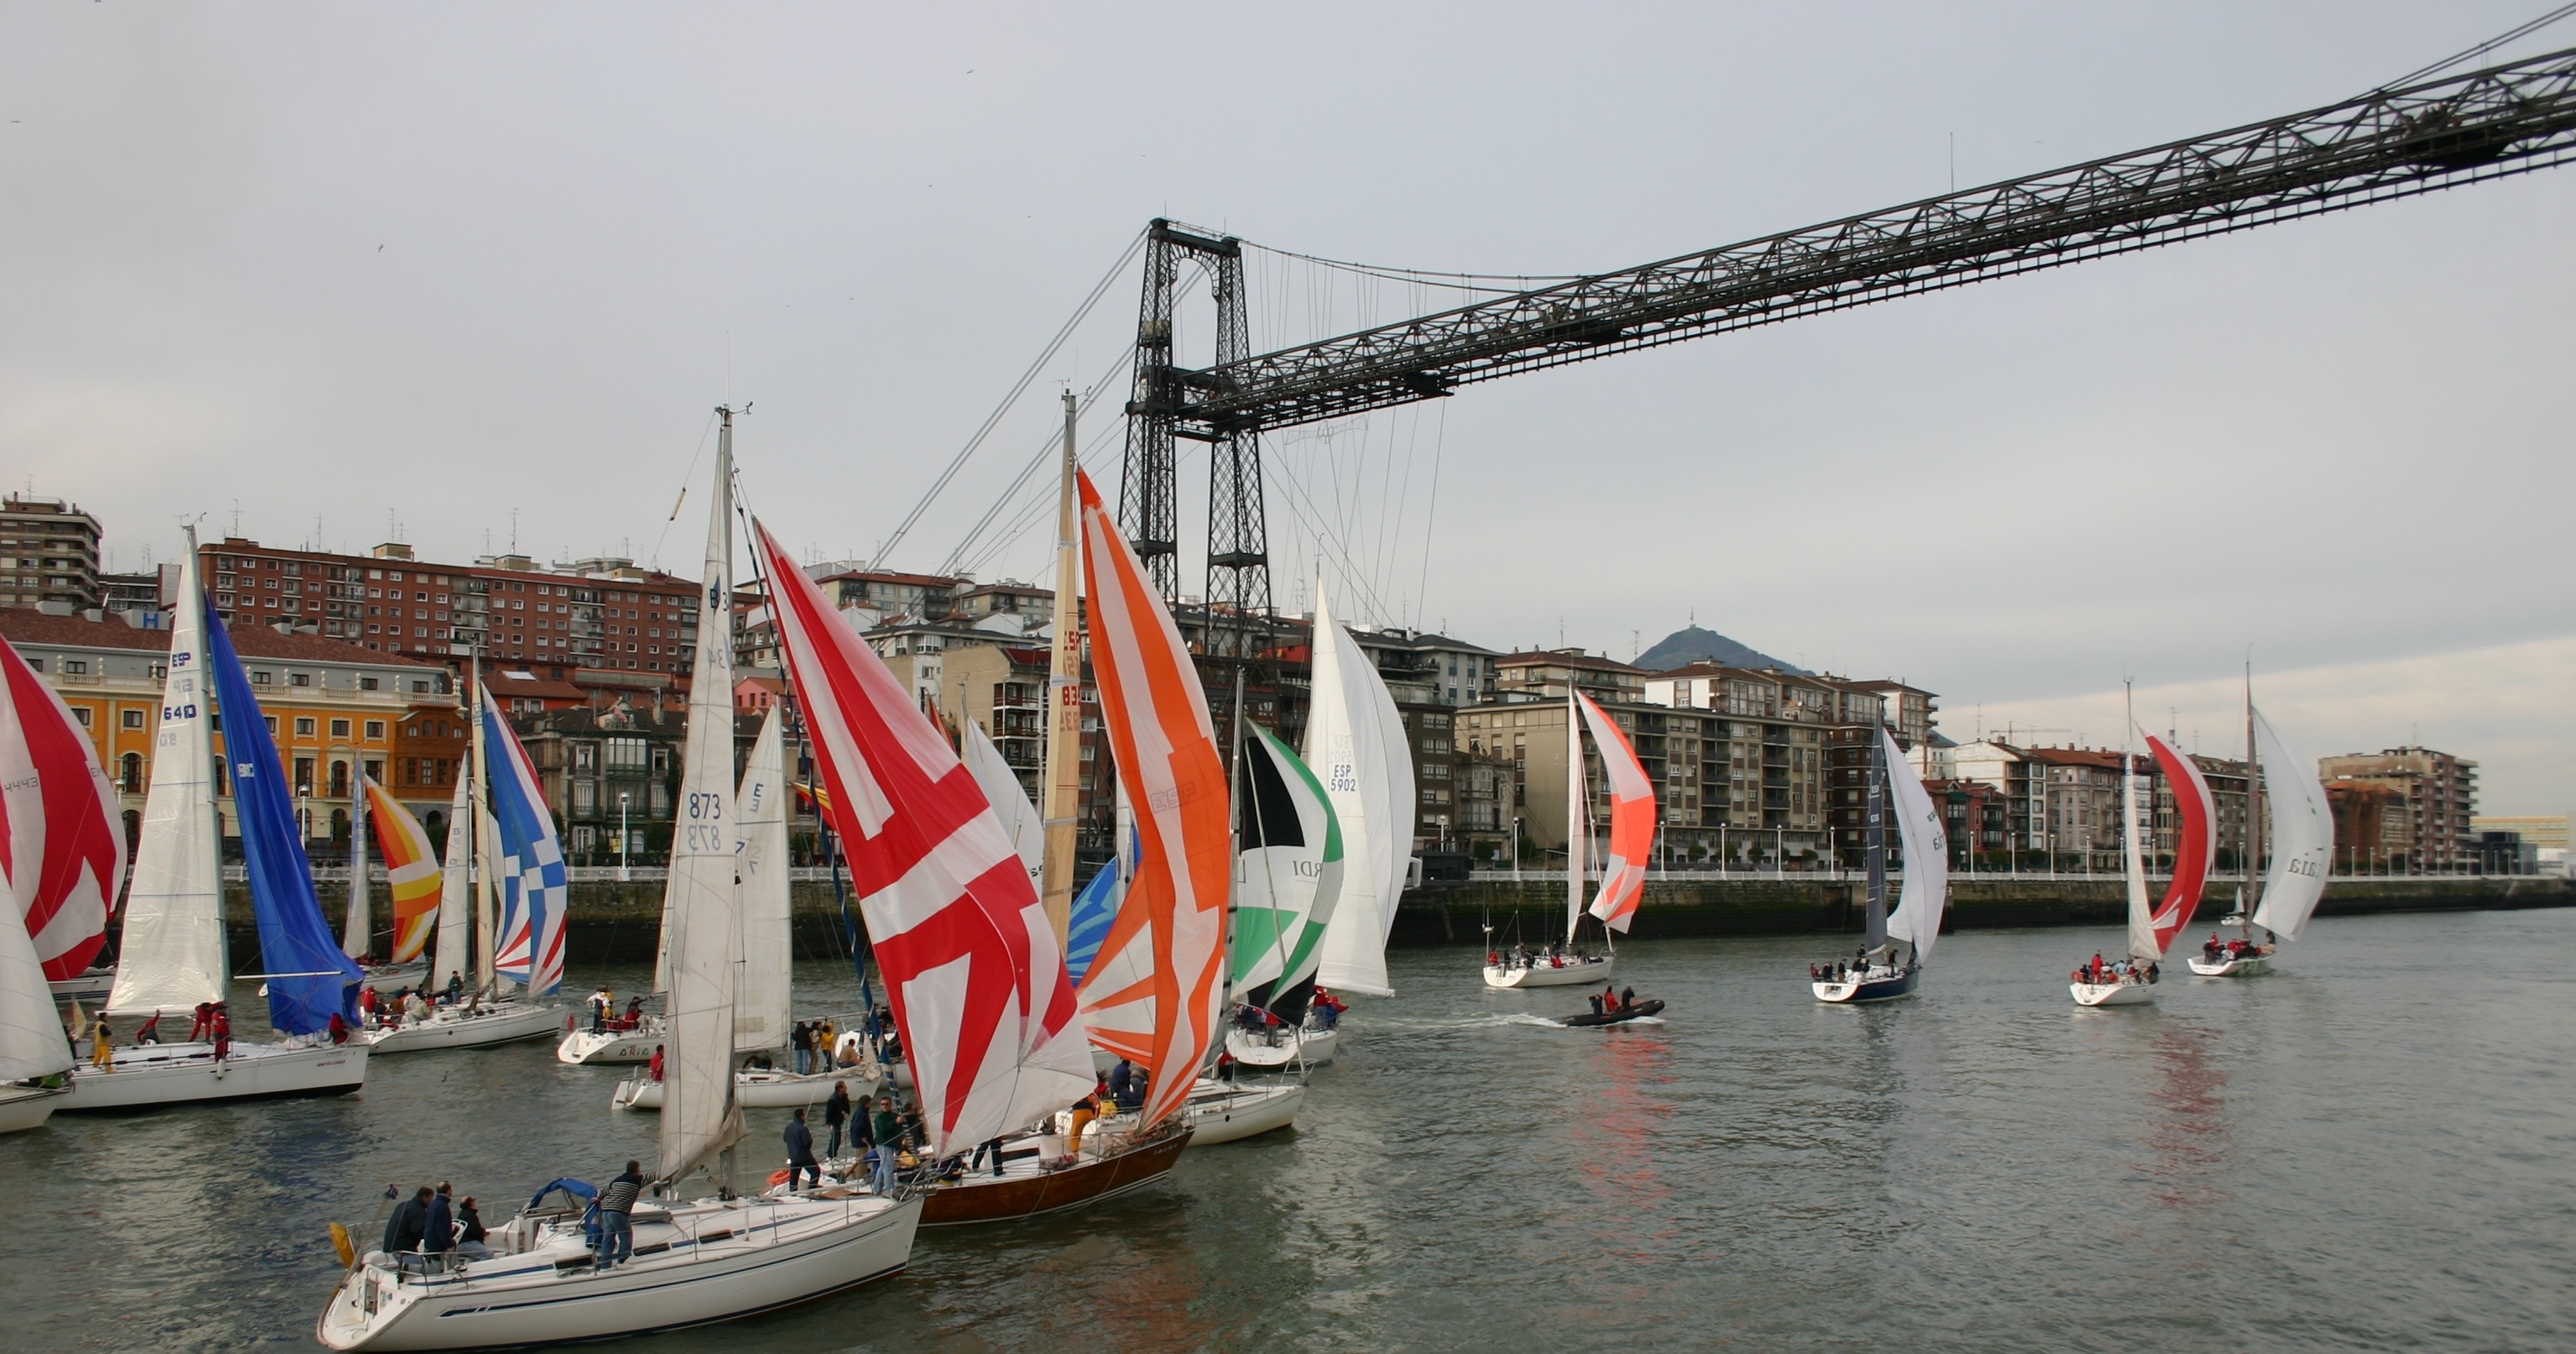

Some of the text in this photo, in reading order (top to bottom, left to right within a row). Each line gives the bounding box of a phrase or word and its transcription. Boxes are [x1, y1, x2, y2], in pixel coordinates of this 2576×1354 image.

[143, 612, 159, 629] H
[1334, 764, 1352, 778] ESP
[1330, 778, 1356, 792] 5902
[1150, 781, 1196, 813] ESP
[689, 792, 722, 820] 873
